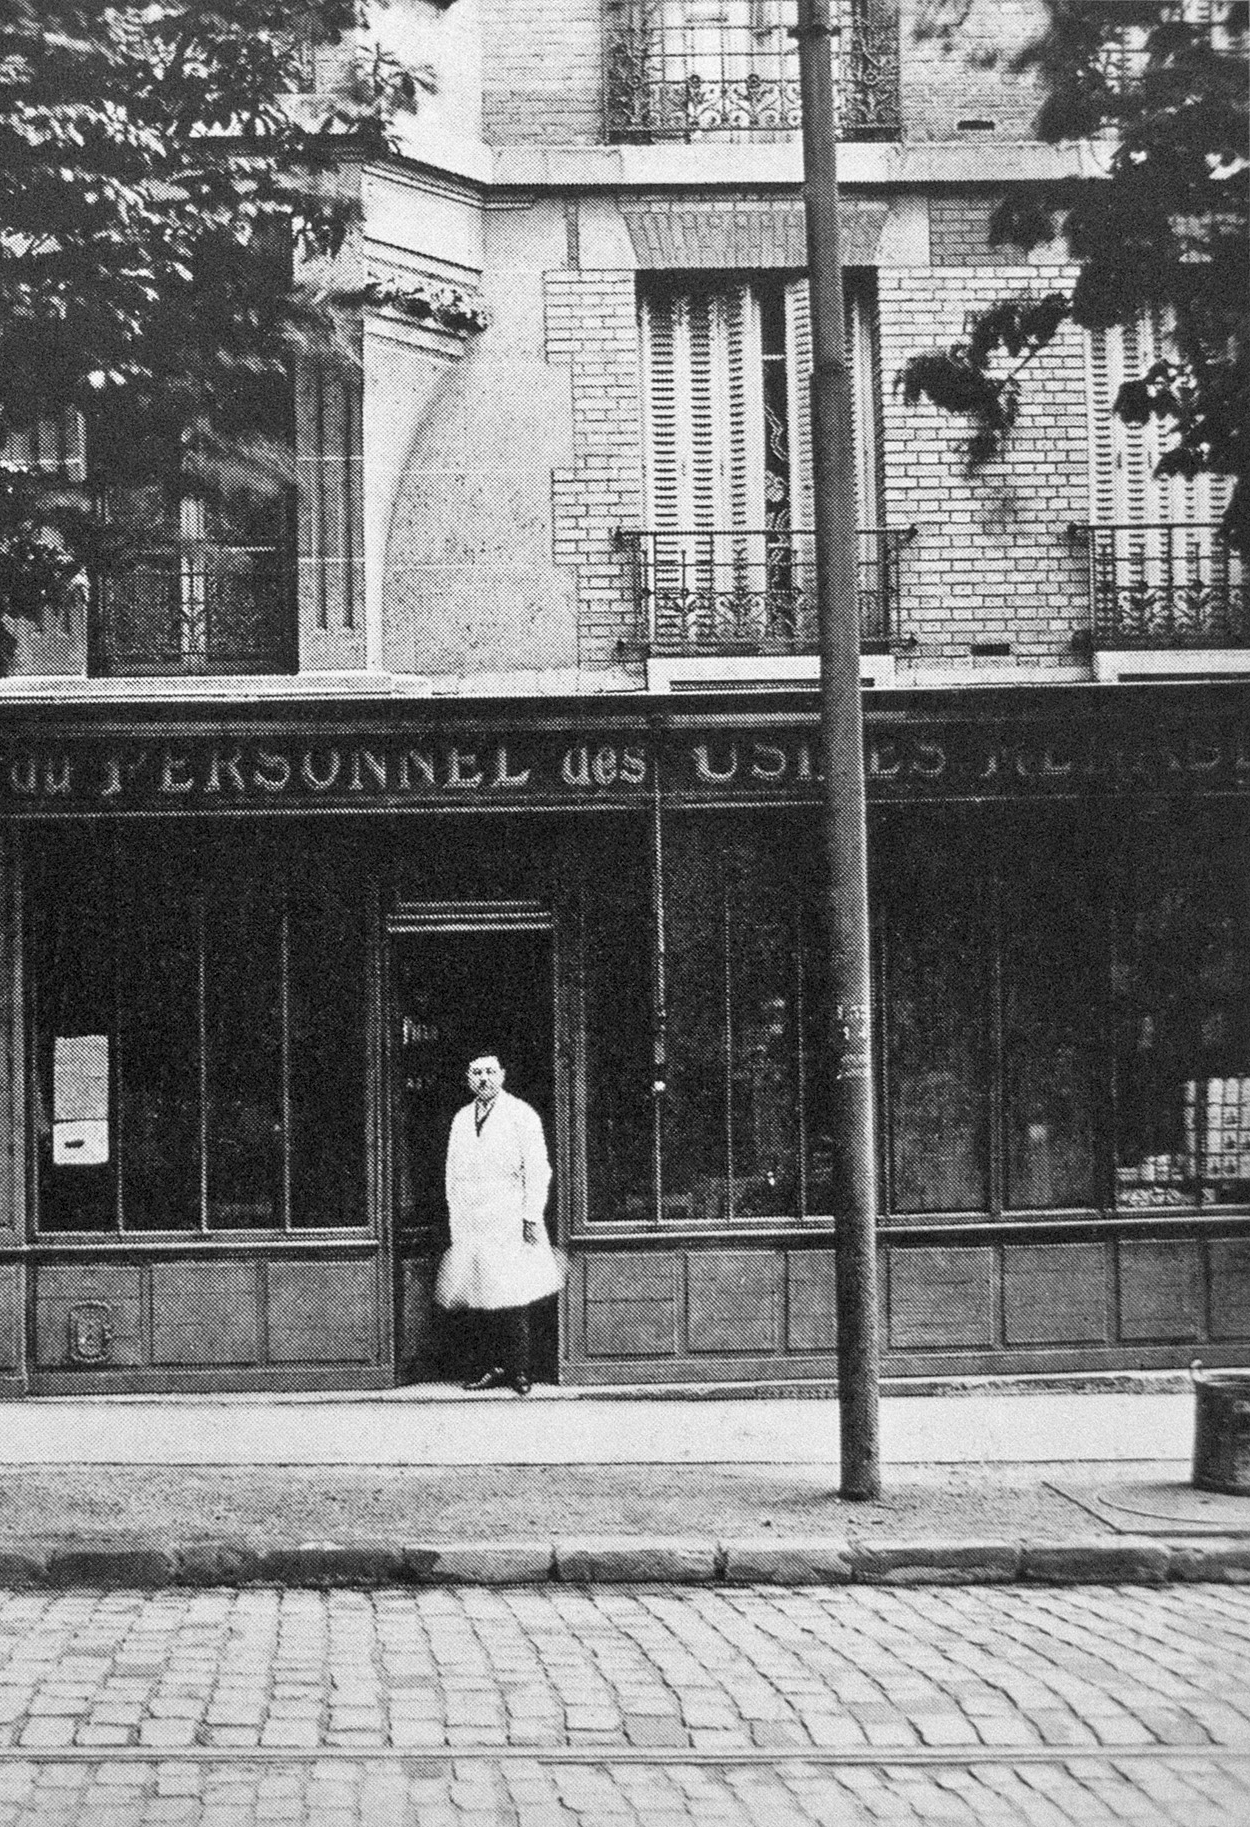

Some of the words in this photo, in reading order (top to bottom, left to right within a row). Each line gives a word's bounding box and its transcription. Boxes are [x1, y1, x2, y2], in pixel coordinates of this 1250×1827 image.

[9, 745, 72, 794] du
[100, 745, 530, 796] PERSONNEL
[561, 743, 648, 787] des
[692, 740, 947, 783] USIES
